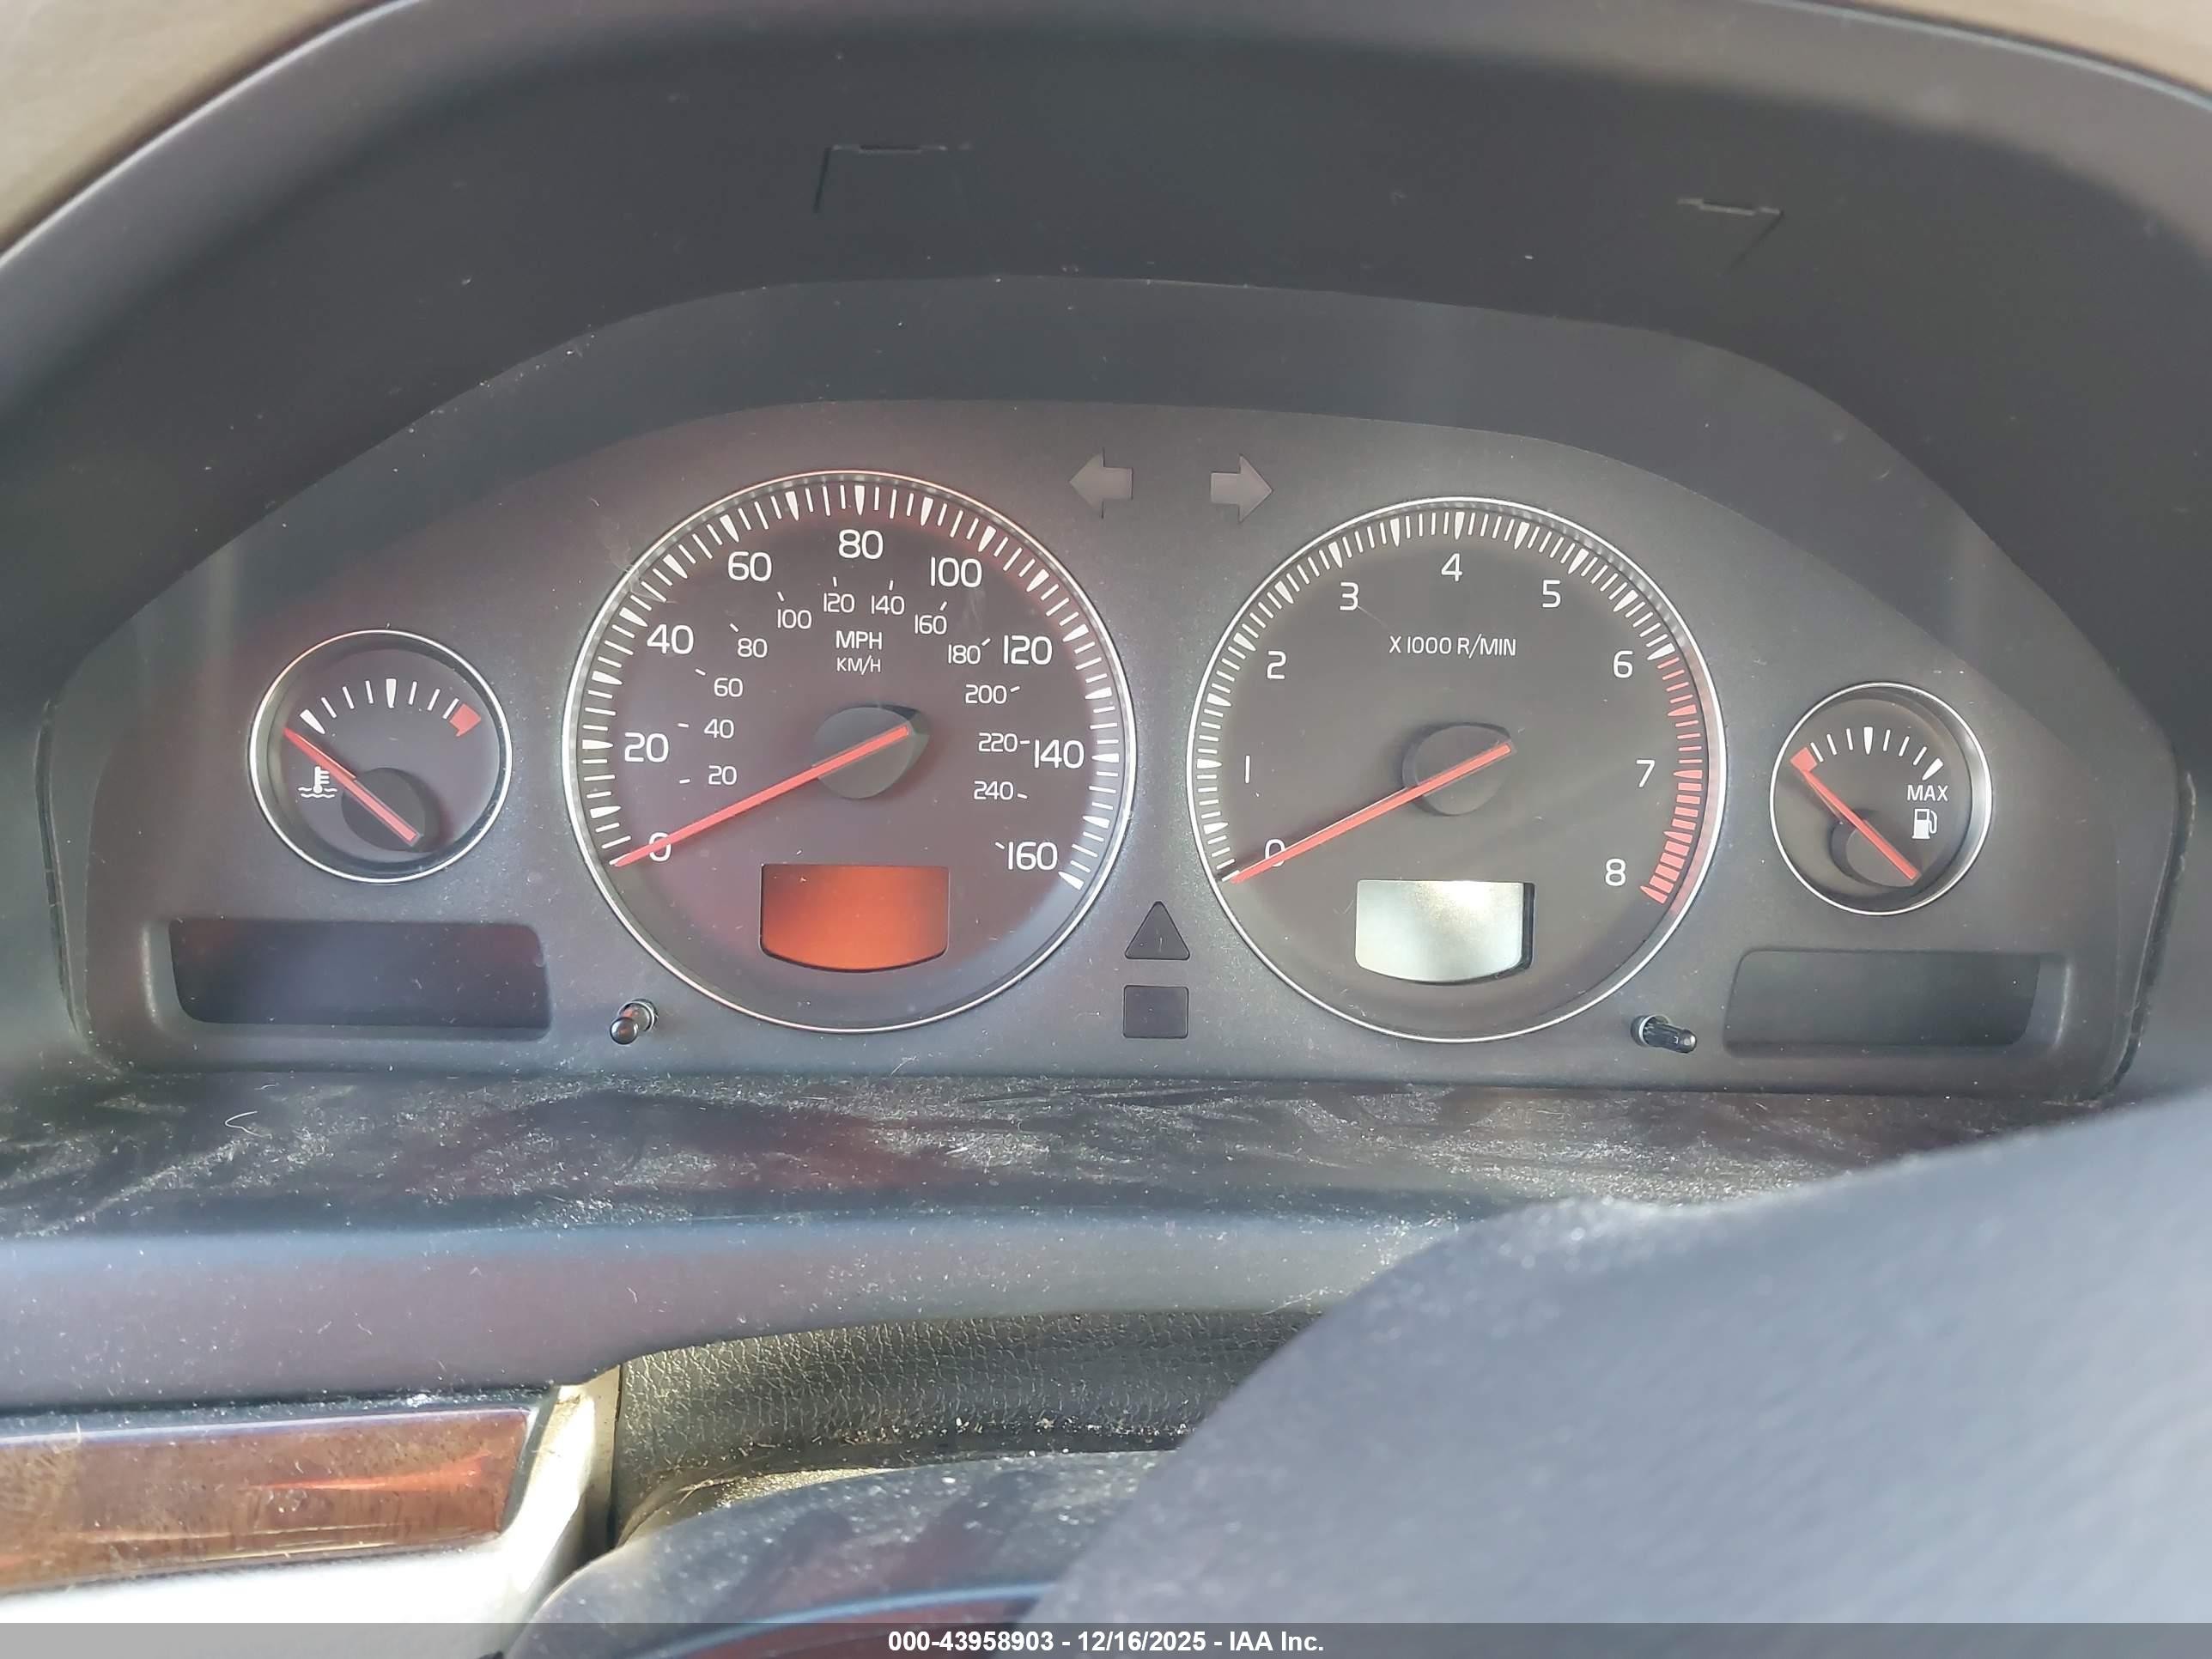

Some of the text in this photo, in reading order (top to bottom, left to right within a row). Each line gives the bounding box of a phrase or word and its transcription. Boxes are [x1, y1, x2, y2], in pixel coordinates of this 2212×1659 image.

[838, 530, 884, 560] 80
[727, 551, 772, 581] 60
[929, 556, 981, 587] 100
[1441, 553, 1462, 581] 4
[823, 592, 854, 614] 120
[871, 595, 905, 616] 140
[1340, 582, 1358, 611] 3
[1541, 579, 1561, 608] 5
[776, 608, 811, 629] 100
[914, 614, 947, 635] 160
[647, 623, 694, 653] 40
[738, 638, 768, 658] 80
[836, 630, 883, 651] MPH
[1002, 635, 1052, 665] 120
[1389, 633, 1516, 658] X 1000 R/MIN
[836, 655, 882, 674] KM/H
[947, 644, 981, 665] 180
[1267, 651, 1287, 679] 2
[1613, 650, 1632, 679] 6
[714, 678, 743, 697] 60
[965, 684, 1007, 704] 200
[704, 719, 734, 738] 40
[978, 732, 1018, 752] 220
[624, 732, 669, 763] 20
[1033, 738, 1085, 769] 140
[708, 765, 737, 786] 20
[1636, 759, 1656, 787] 7
[973, 781, 1014, 800] 240
[1906, 785, 1948, 802] MAX
[647, 831, 672, 862] 0
[1006, 841, 1058, 870] 160
[1265, 839, 1286, 868] 0
[1605, 858, 1626, 886] 8
